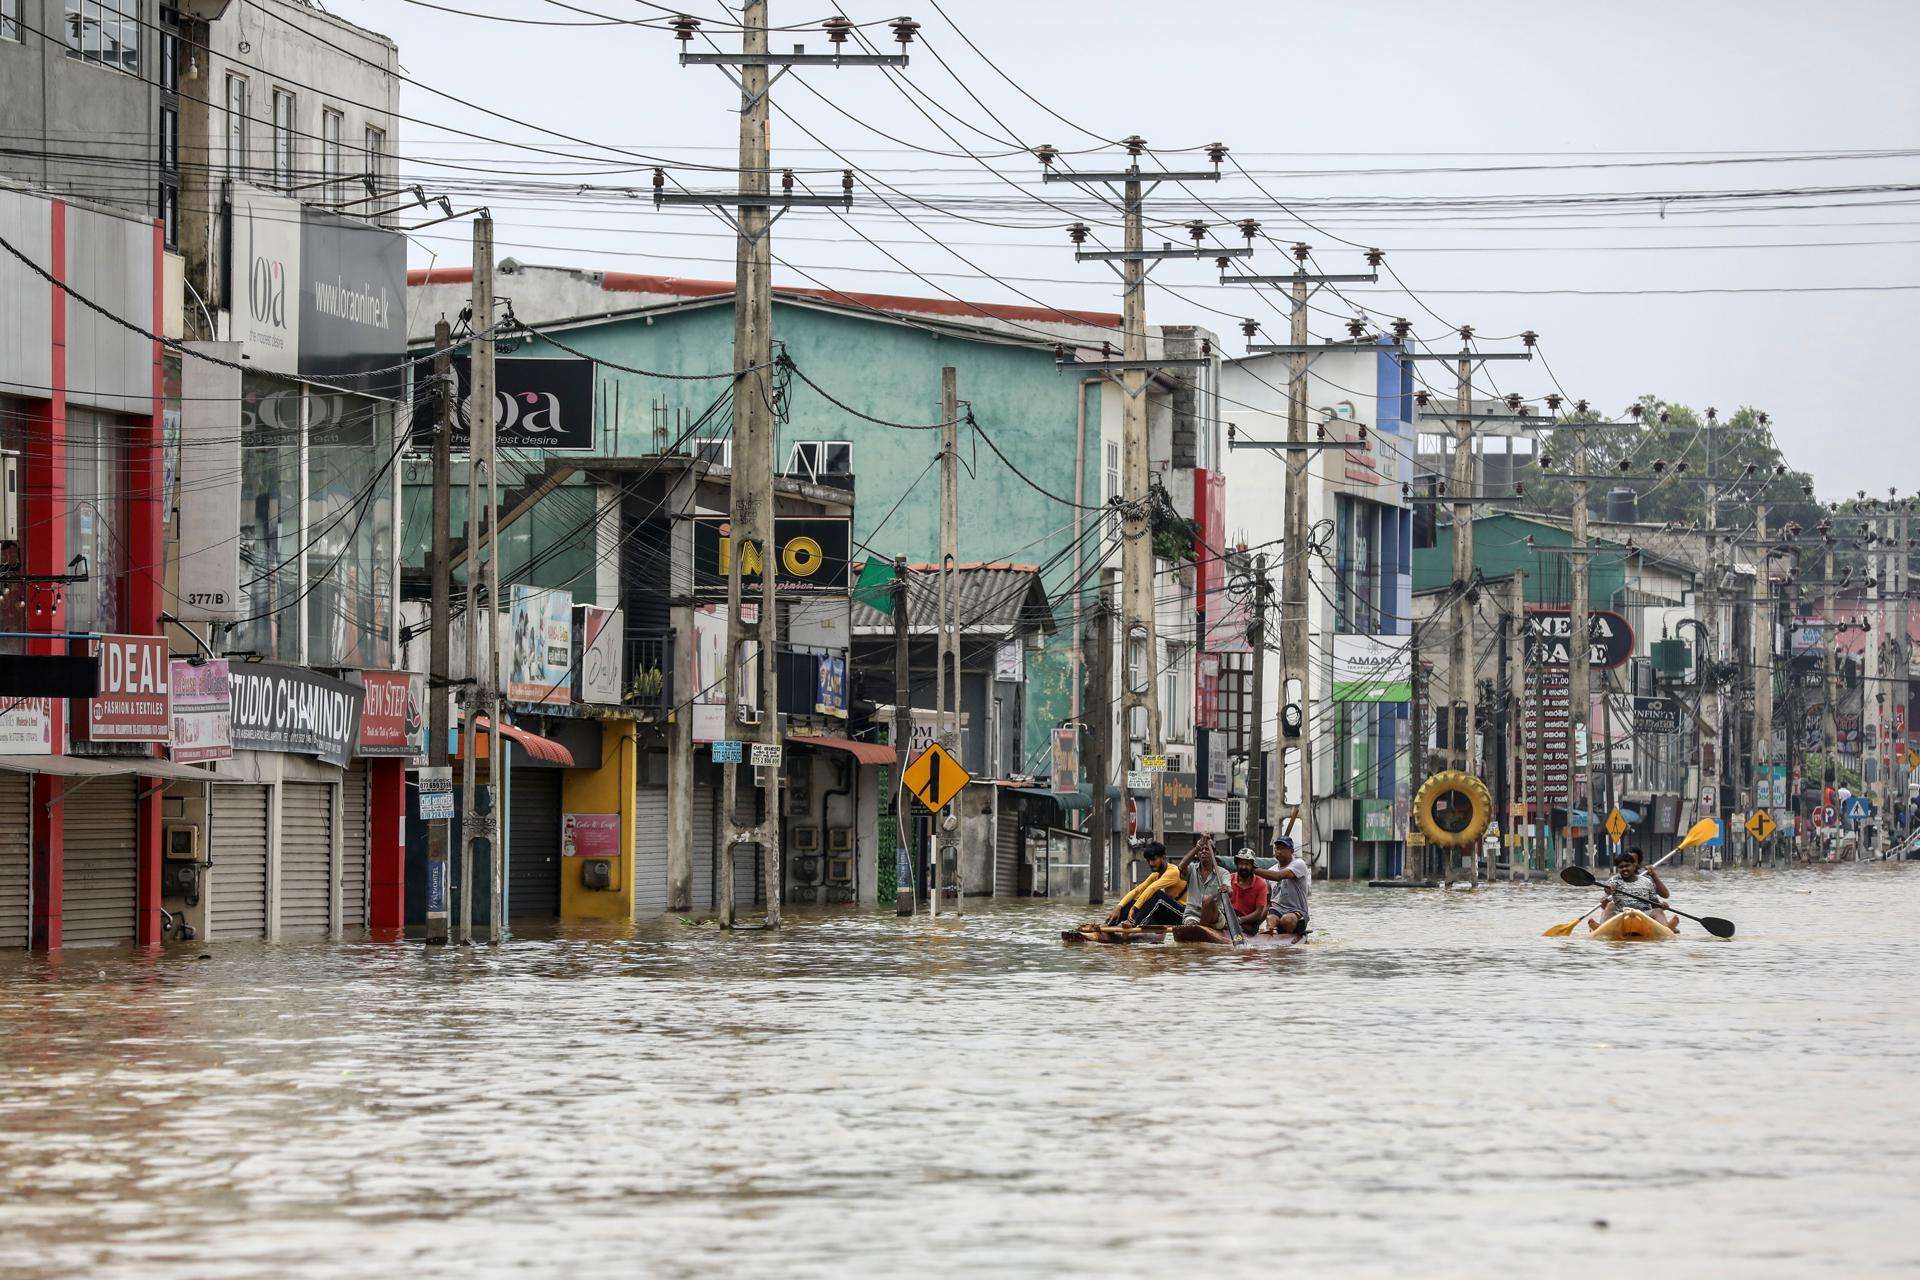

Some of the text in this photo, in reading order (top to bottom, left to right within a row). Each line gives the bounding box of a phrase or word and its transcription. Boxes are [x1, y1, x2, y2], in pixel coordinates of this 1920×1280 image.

[315, 275, 390, 329] www.loraonline.lk
[522, 436, 558, 445] desire
[188, 593, 224, 605] 377/B
[1530, 617, 1614, 637] MEA
[1347, 656, 1403, 666] AMANA
[1531, 643, 1608, 663] SAE
[228, 672, 273, 727] STUDIO
[275, 678, 355, 743] CHAMINDU
[362, 679, 406, 717] NEW STEP
[105, 701, 129, 714] FASHION
[131, 702, 134, 715] &
[135, 702, 163, 716] TEXTILES
